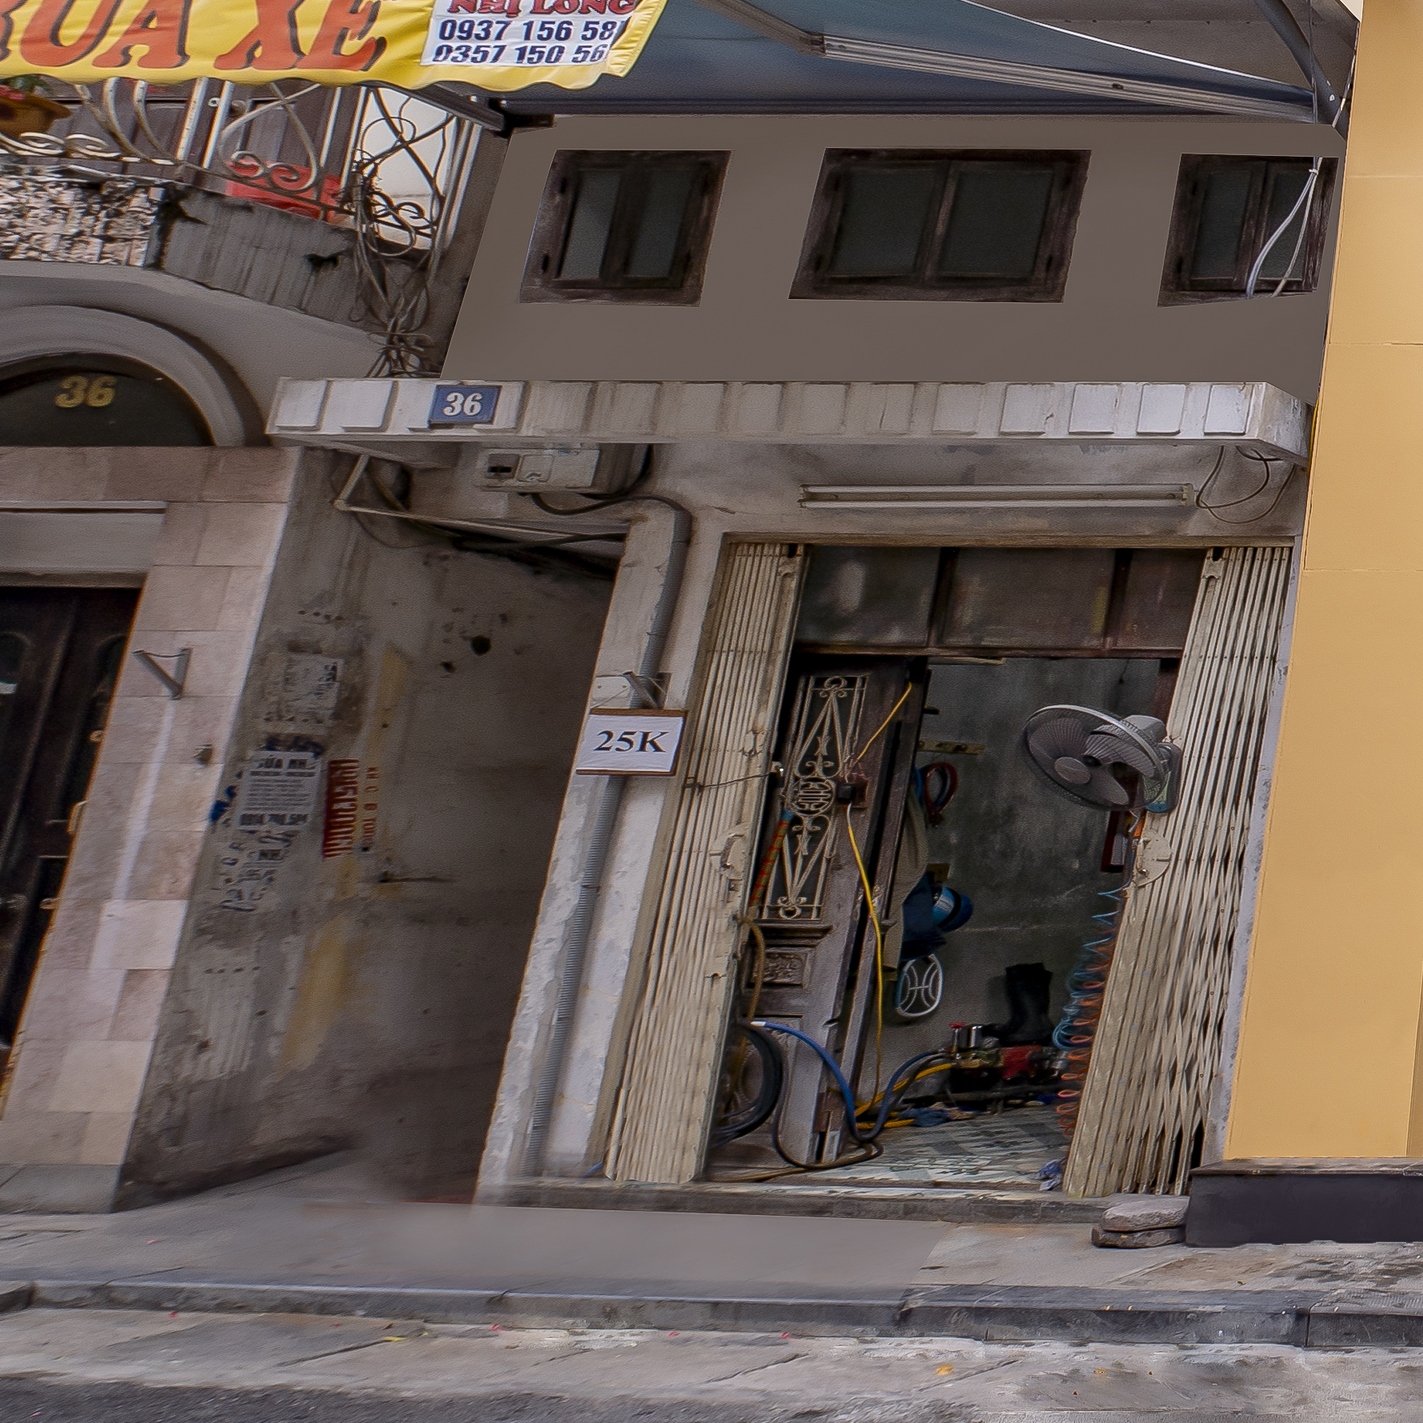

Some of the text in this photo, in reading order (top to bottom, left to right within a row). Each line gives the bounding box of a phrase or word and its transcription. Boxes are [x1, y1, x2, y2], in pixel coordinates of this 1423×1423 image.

[438, 19, 625, 42] 0937 156 58
[432, 43, 609, 63] 0357 150 56
[55, 377, 117, 409] 36
[442, 392, 483, 418] 36
[592, 728, 670, 754] 25K
